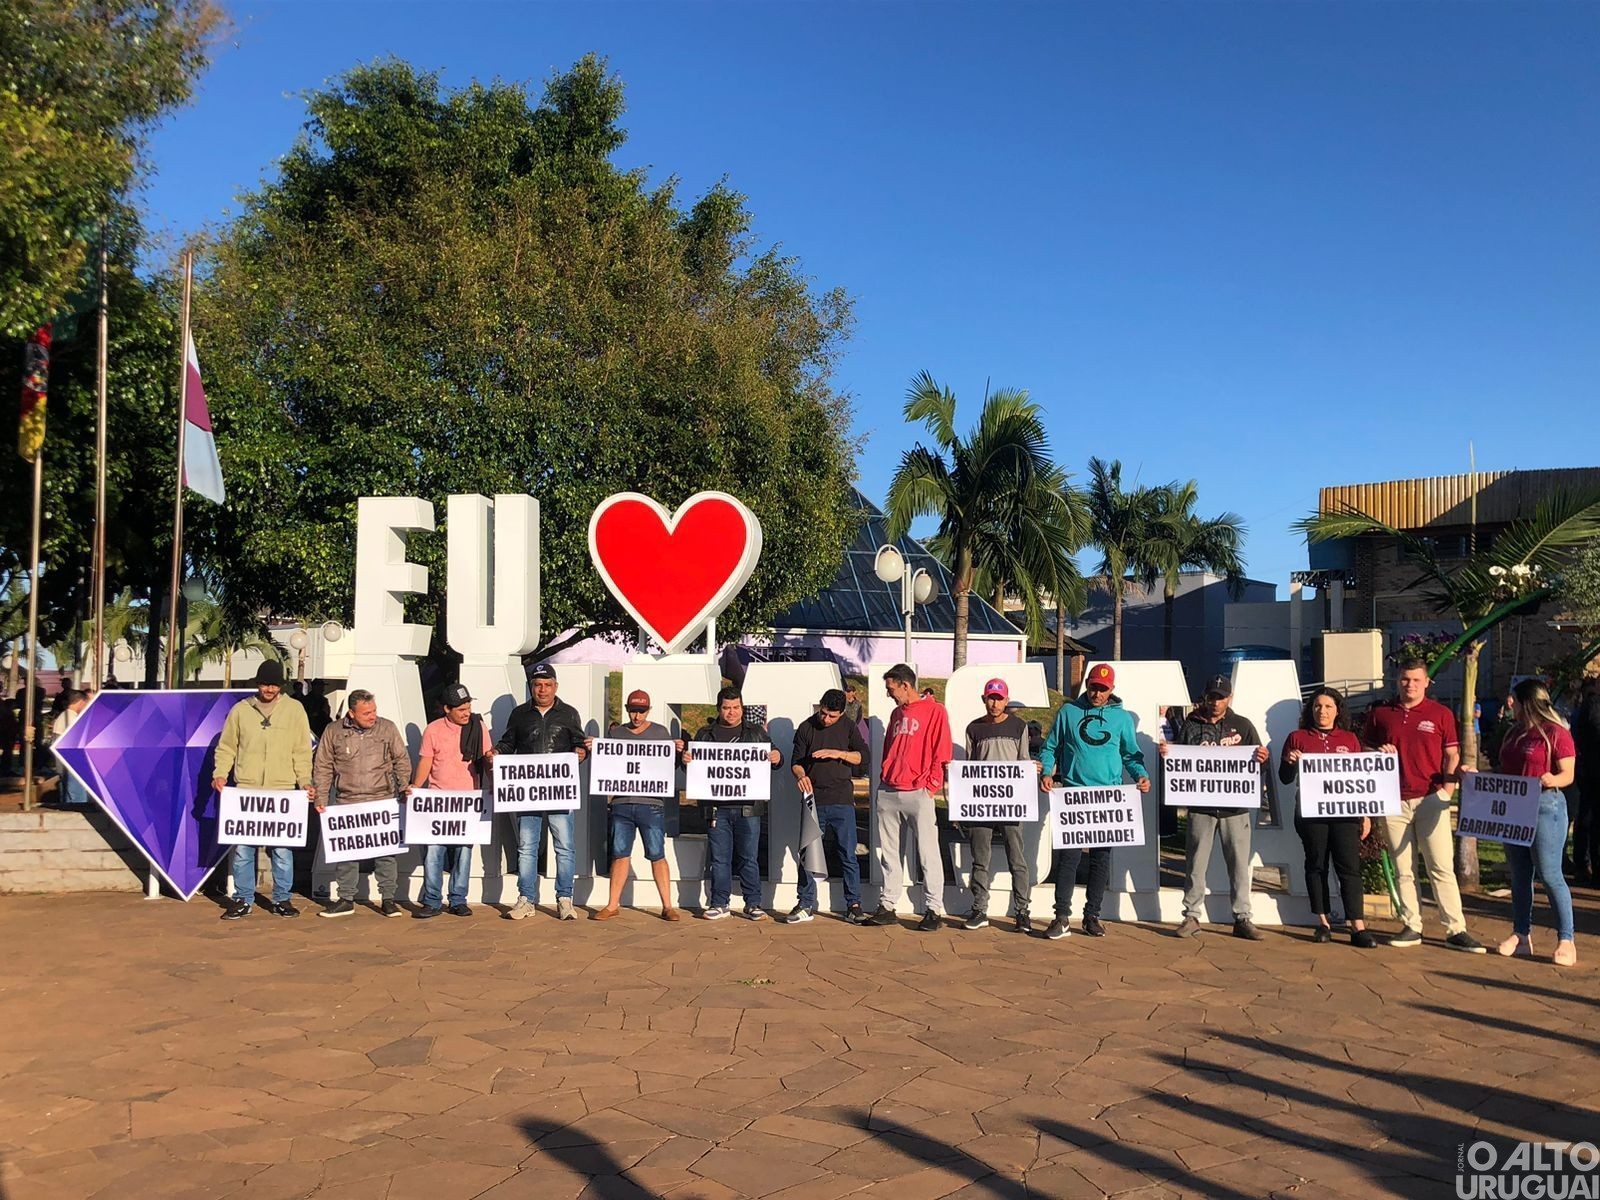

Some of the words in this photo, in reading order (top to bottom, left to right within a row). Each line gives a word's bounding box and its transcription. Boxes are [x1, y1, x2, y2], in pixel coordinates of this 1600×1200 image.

[355, 493, 541, 656] EU
[892, 716, 921, 737] GAP
[597, 743, 623, 755] PELO
[627, 744, 670, 757] DIREITO
[692, 745, 768, 763] MINERAÇÃO
[627, 762, 640, 774] DE
[1166, 759, 1192, 772] SEM
[1196, 758, 1260, 773] GARIMPO,
[1303, 755, 1394, 773] MINERAÇÃO
[500, 764, 573, 780] TRABALHO,
[708, 767, 750, 779] NOSSA
[962, 766, 1023, 778] AMETISTA:
[498, 785, 524, 802] NÃO
[529, 785, 576, 800] CRIME!
[598, 780, 667, 793] TRABALHAR!
[711, 785, 746, 796] VIDA!
[973, 785, 1013, 798] NOSSO
[1171, 779, 1196, 792] SEM
[1201, 780, 1254, 793] FUTURO!
[1323, 779, 1375, 794] NOSSO
[1475, 777, 1527, 796] RESPEITO
[240, 797, 275, 812] VIVA
[280, 798, 289, 813] O
[413, 796, 488, 814] GARIMPO,
[1064, 790, 1125, 805] GARIMPO:
[961, 804, 1026, 817] SUSTENTO!
[1318, 801, 1384, 815] FUTURO!
[1492, 800, 1506, 816] AO
[328, 812, 401, 830] GARIMPO=
[1060, 809, 1121, 825] SUSTENTO
[1127, 810, 1133, 821] E
[225, 820, 302, 838] GARIMPO!
[432, 821, 466, 836] SIM!
[1460, 817, 1535, 843] GARIMPEIRO!
[329, 829, 404, 851] TRABALHO!
[1063, 829, 1134, 844] DIGNIDADE!
